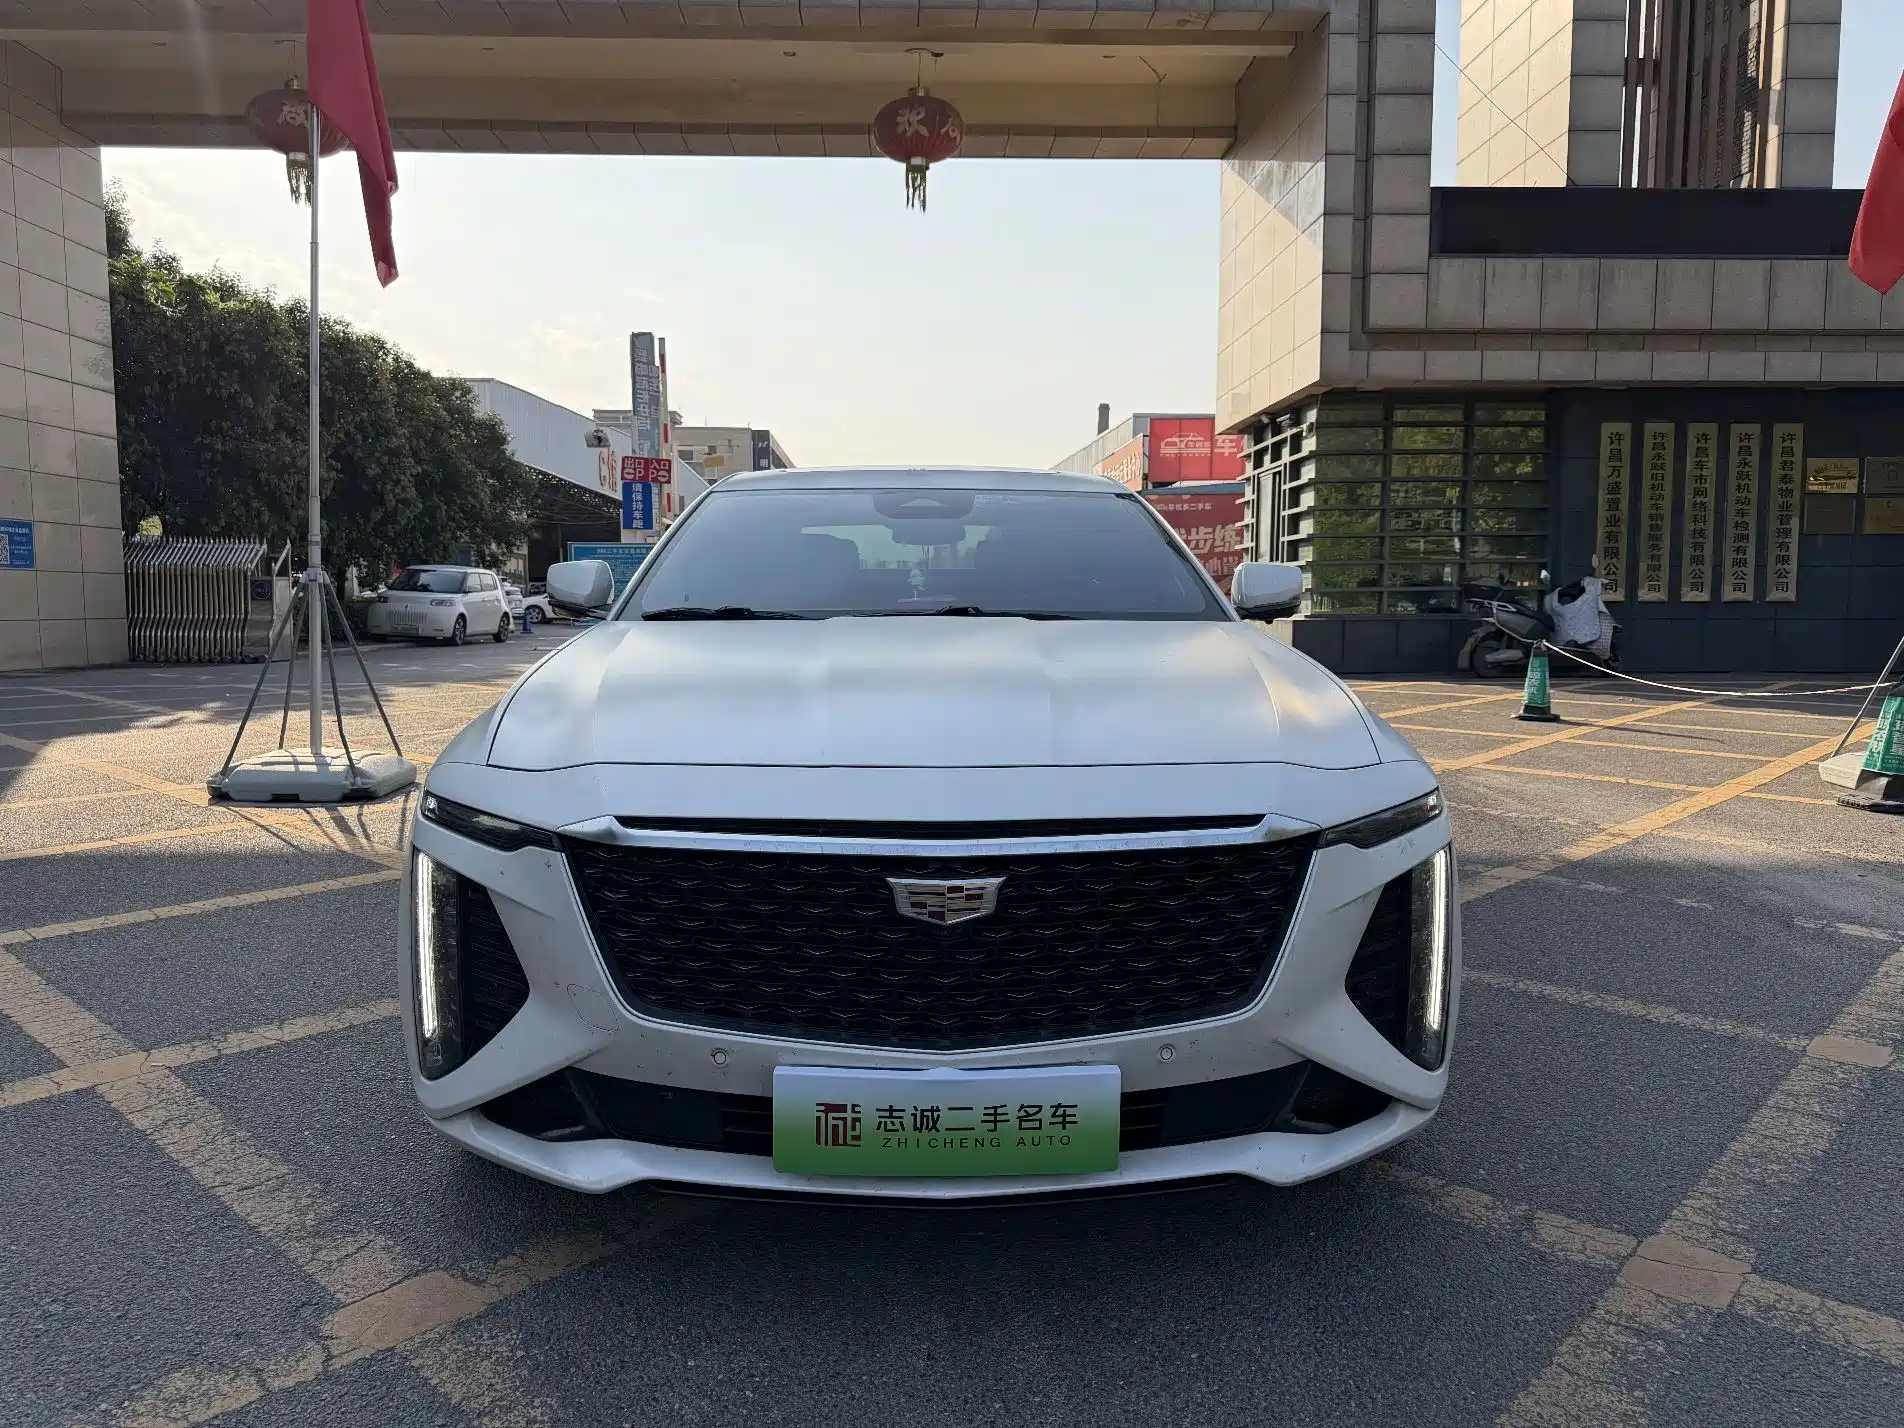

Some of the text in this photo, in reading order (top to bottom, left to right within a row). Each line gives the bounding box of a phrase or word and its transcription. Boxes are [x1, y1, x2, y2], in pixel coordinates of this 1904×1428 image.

[624, 458, 644, 468] 出口
[636, 469, 645, 480] P
[649, 470, 657, 481] P
[650, 459, 669, 469] 入口
[631, 483, 644, 529] 请保持车距
[1603, 432, 1625, 593] 许昌万盛置业有限公司
[1646, 432, 1669, 593] 许昌永跃旧机动车销售服务有限公司
[1688, 432, 1712, 593] 许昌车市网络科技有限公司
[1731, 432, 1755, 593] 许昌永跃机动车检测有限公司
[1774, 432, 1797, 593] 许昌君泰物业管理有限公司
[875, 1103, 1079, 1133] 志诚二手名车
[882, 1135, 1071, 1149] ZHICHENG AUTO
